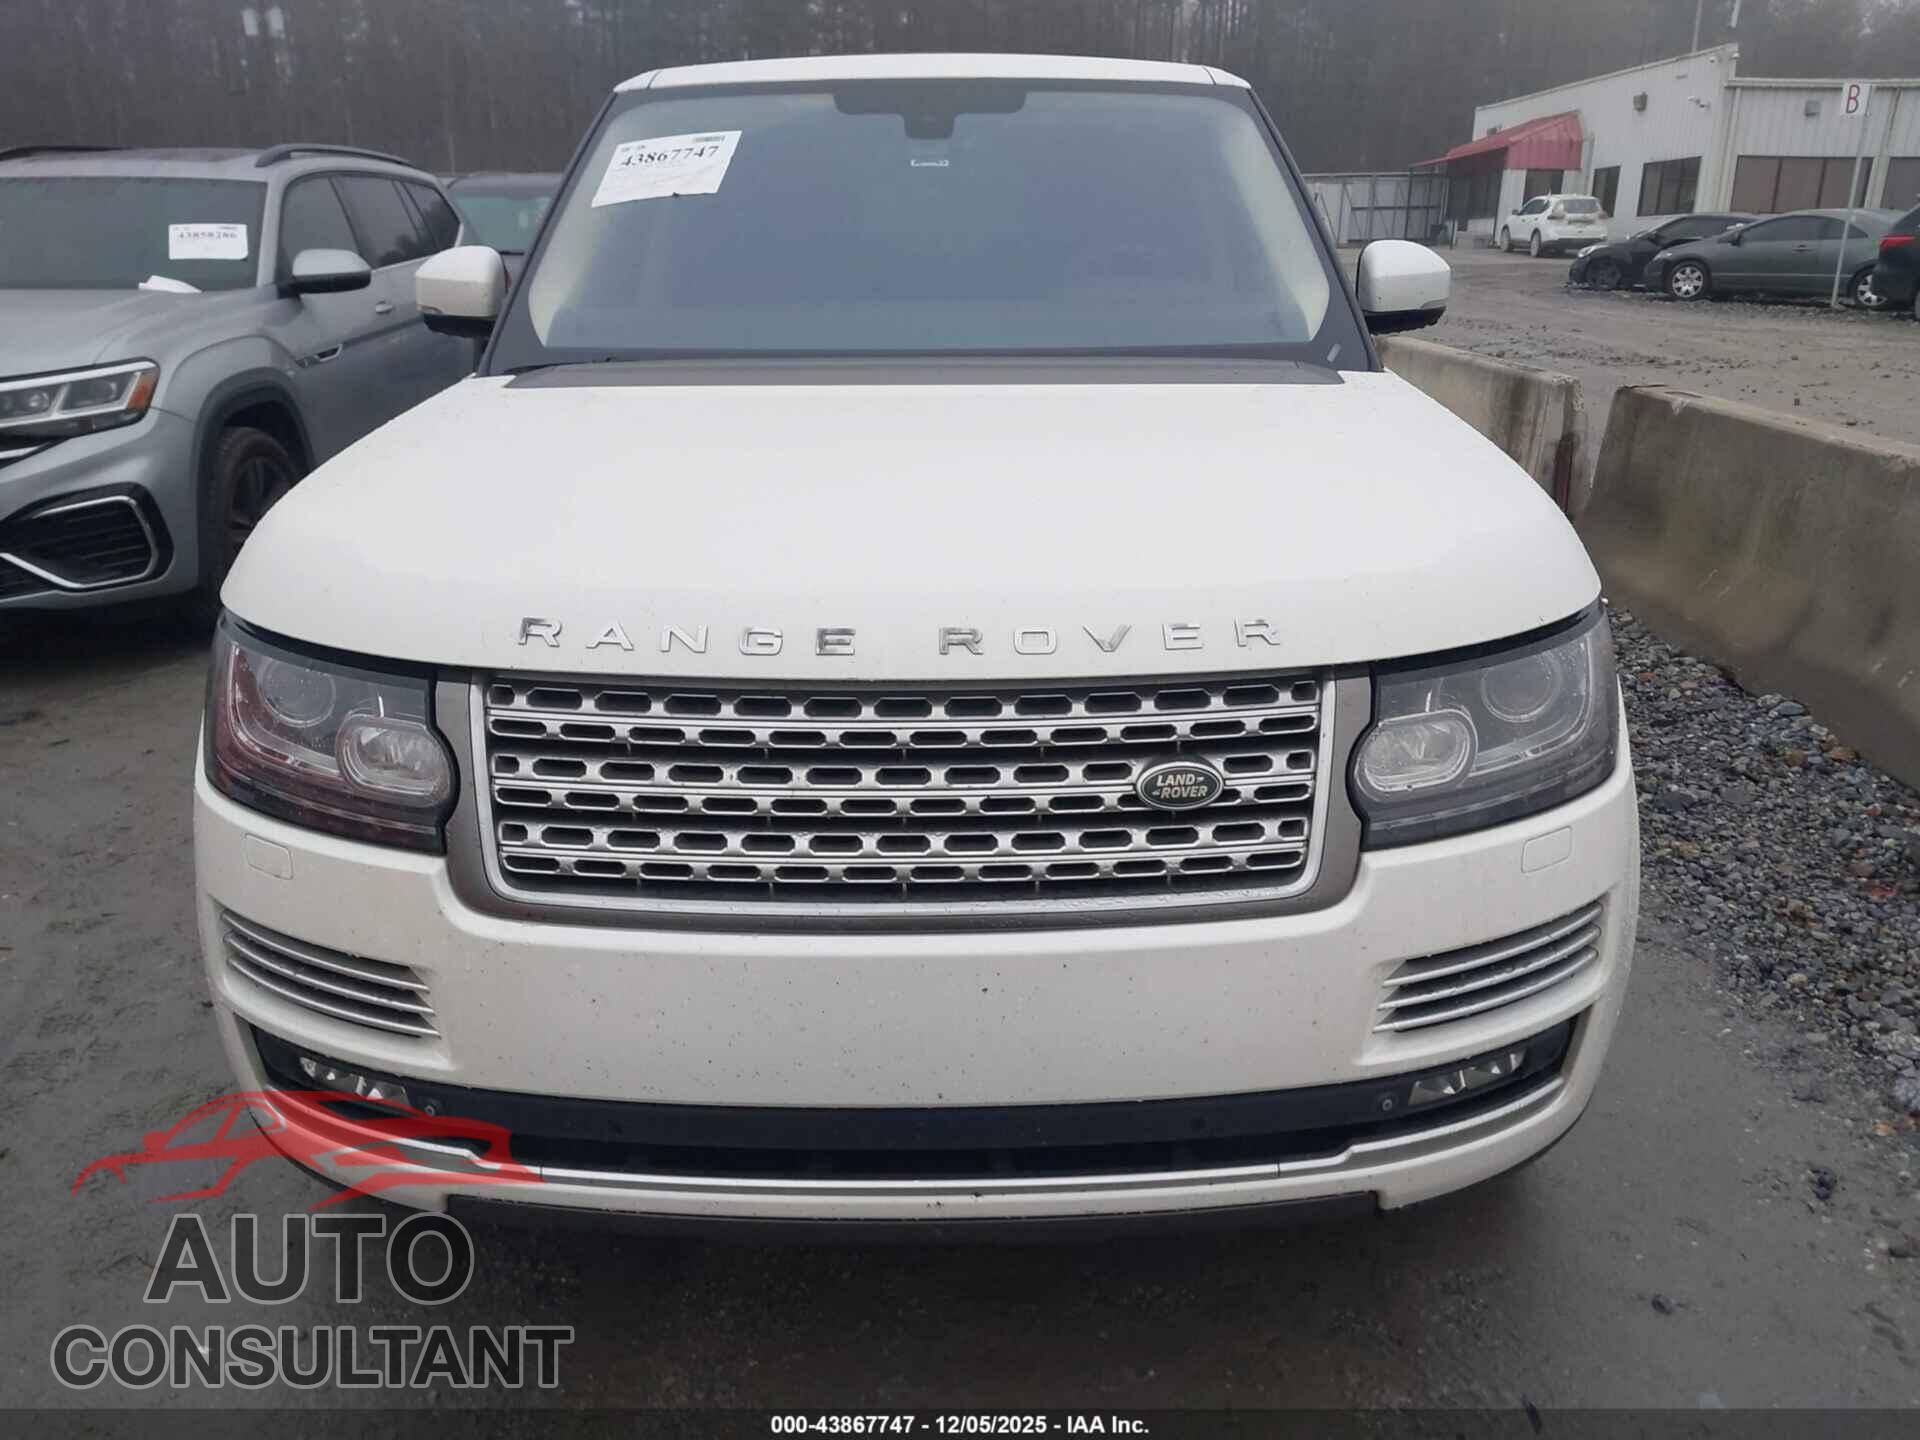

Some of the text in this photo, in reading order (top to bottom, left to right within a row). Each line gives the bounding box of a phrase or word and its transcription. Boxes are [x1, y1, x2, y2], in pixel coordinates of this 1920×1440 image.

[1846, 84, 1860, 114] B
[620, 145, 719, 167] 43867747
[517, 615, 1281, 657] RANGE ROVER
